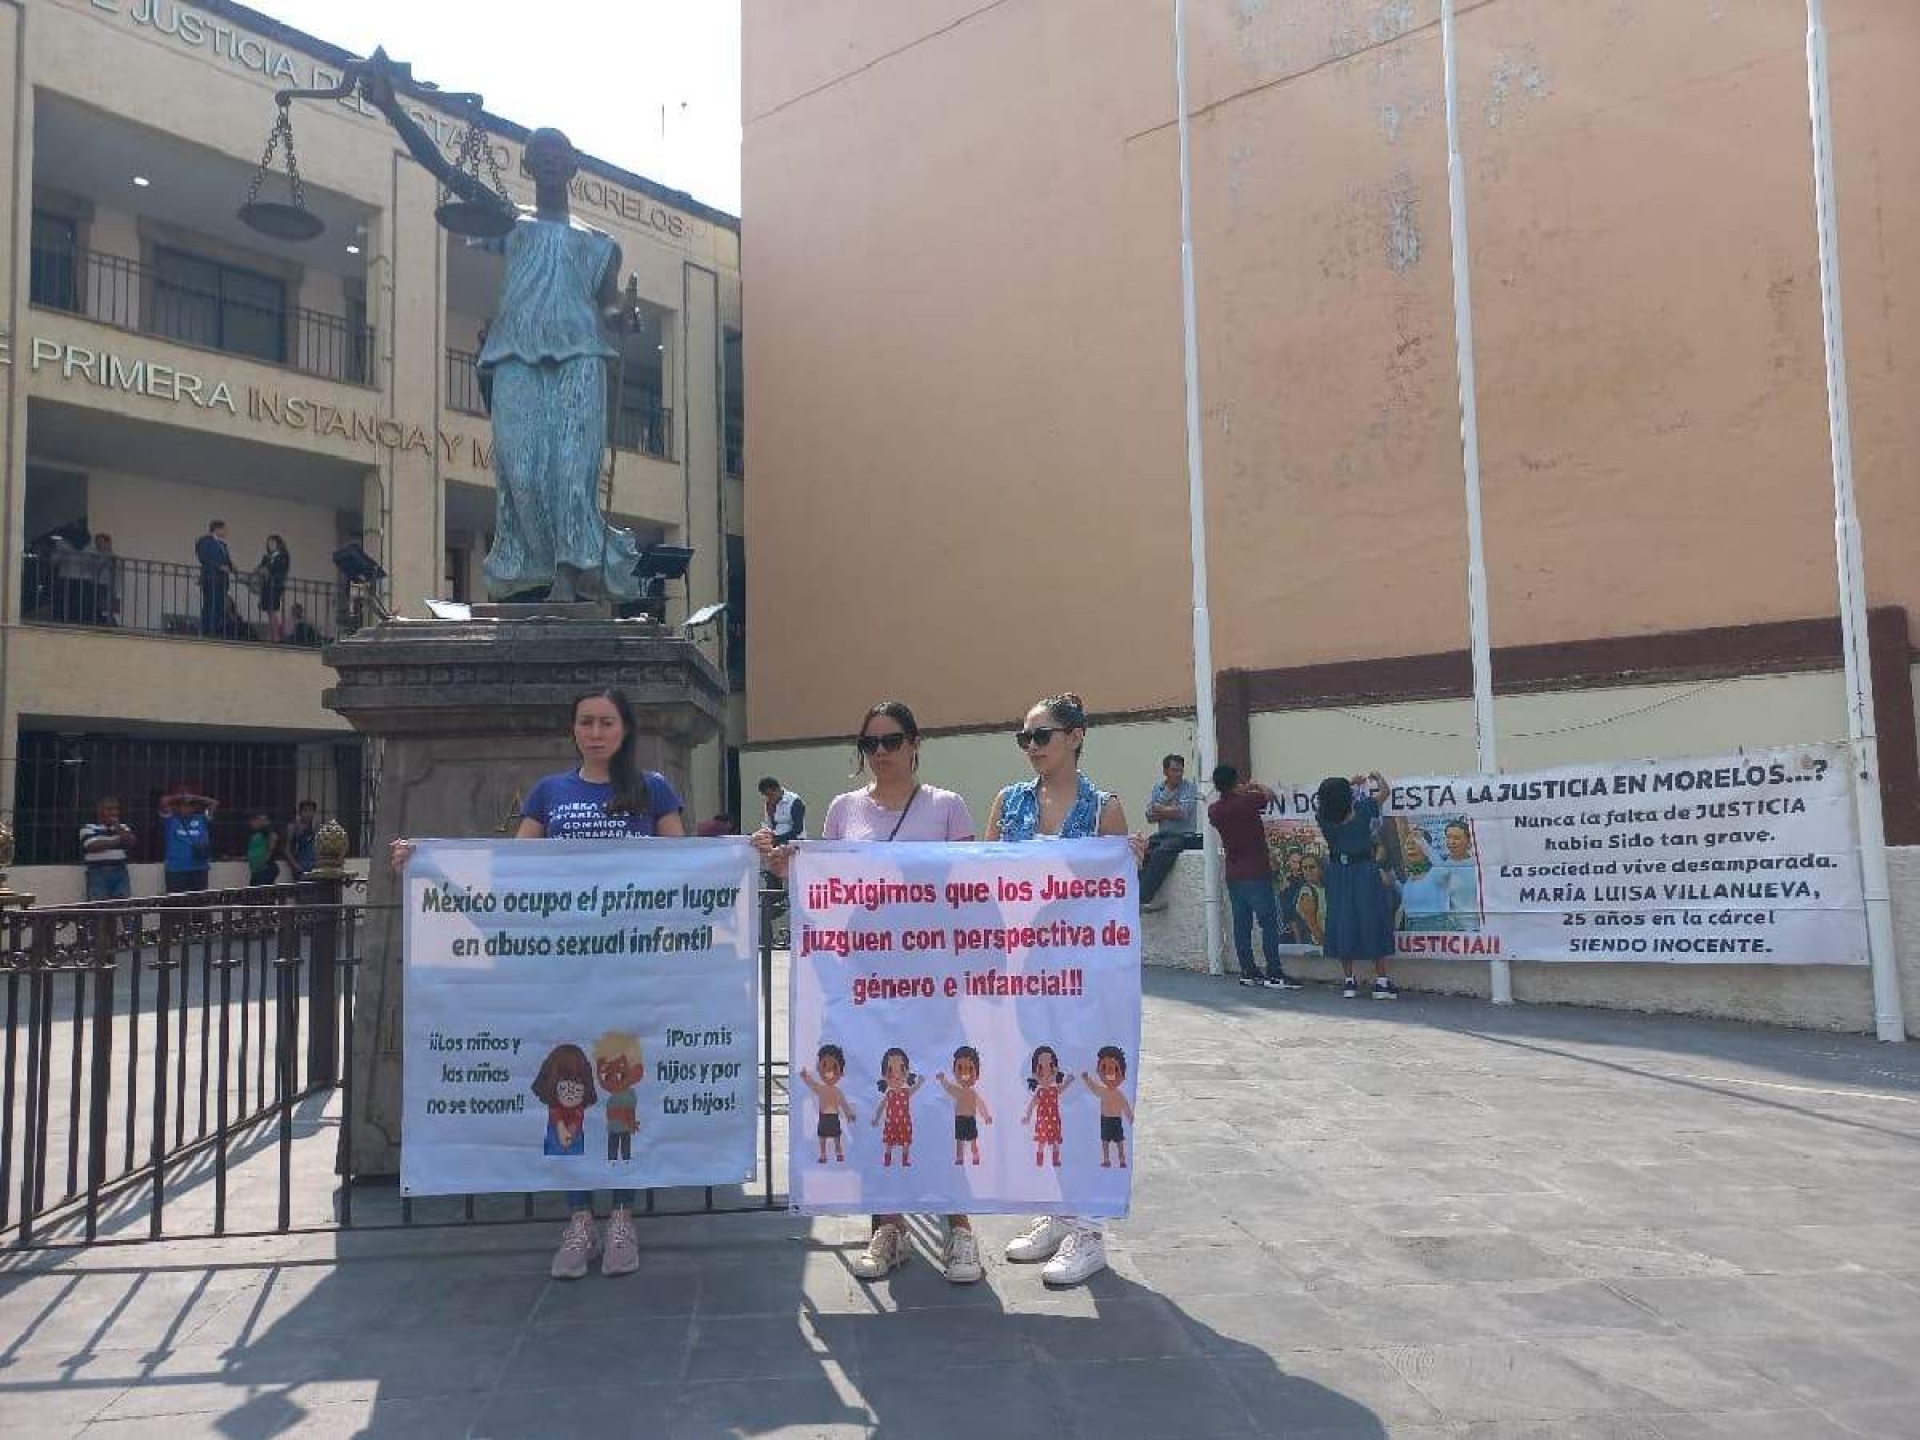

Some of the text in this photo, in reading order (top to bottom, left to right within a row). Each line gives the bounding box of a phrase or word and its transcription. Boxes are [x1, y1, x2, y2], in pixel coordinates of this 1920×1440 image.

[31, 336, 237, 414] PRIMERA
[248, 386, 432, 457] INSTANCIA
[438, 430, 462, 462] Y
[1467, 785, 1494, 804] LA
[1498, 776, 1608, 803] JUSTICIA
[1613, 774, 1646, 795] EN
[1514, 797, 1806, 829] Nunca la falta de JUSTICIA
[1608, 832, 1655, 850] Sido
[1661, 832, 1698, 847] tan
[1704, 829, 1776, 848] grave.
[1500, 853, 1838, 878] La sociedad vive desamparada.
[422, 882, 740, 918] México ocupa el primer lugar
[945, 881, 990, 909] que
[998, 876, 1032, 901] los
[1040, 874, 1126, 899] Jueces
[1594, 884, 1657, 902] LUISA
[1663, 880, 1821, 901] VILLANUEVA,
[1562, 909, 1776, 927] 25 años en la cárcel
[452, 938, 479, 958] en
[485, 931, 550, 957] abuso
[556, 928, 625, 956] sexual
[801, 919, 1131, 957] juzguen con perspectiva de
[1570, 937, 1774, 954] SIENDO INOCENTE.
[854, 968, 1083, 1006] género e infancia!!!
[467, 1029, 510, 1051] niños
[512, 1036, 521, 1055] y
[703, 1027, 732, 1047] mis
[442, 1062, 509, 1083] las niñas
[657, 1061, 742, 1084] hijos y por
[426, 1099, 446, 1115] no
[449, 1100, 467, 1115] se
[663, 1092, 736, 1116] tus hijos!
